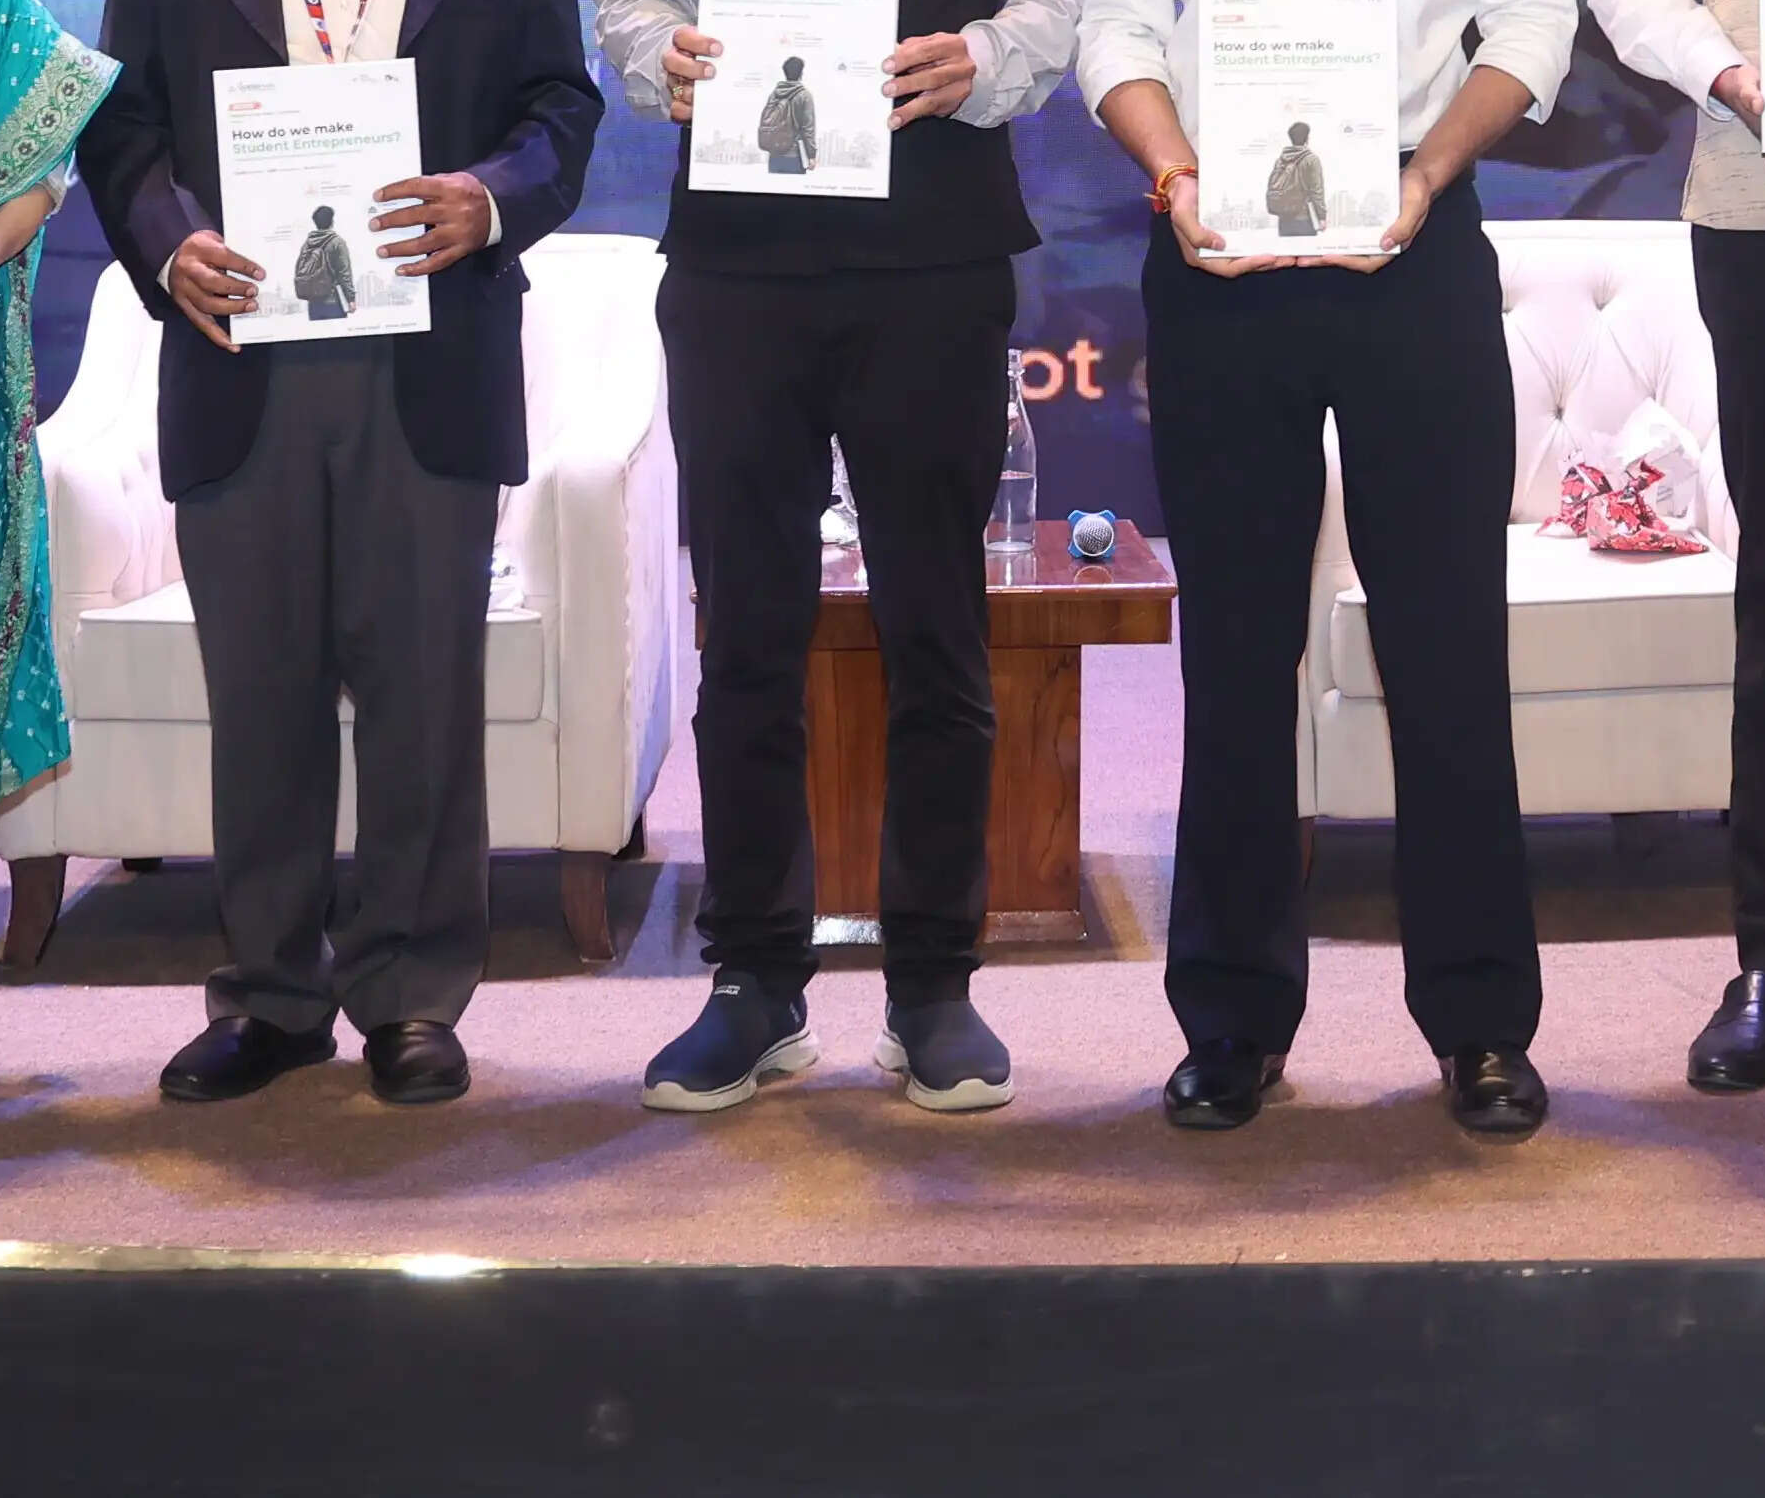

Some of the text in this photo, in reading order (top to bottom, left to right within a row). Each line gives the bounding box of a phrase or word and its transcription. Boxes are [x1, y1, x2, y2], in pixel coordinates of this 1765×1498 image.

[1214, 40, 1334, 52] How do we make
[1214, 54, 1268, 66] Student
[232, 122, 353, 140] How do we make
[232, 140, 288, 155] Student
